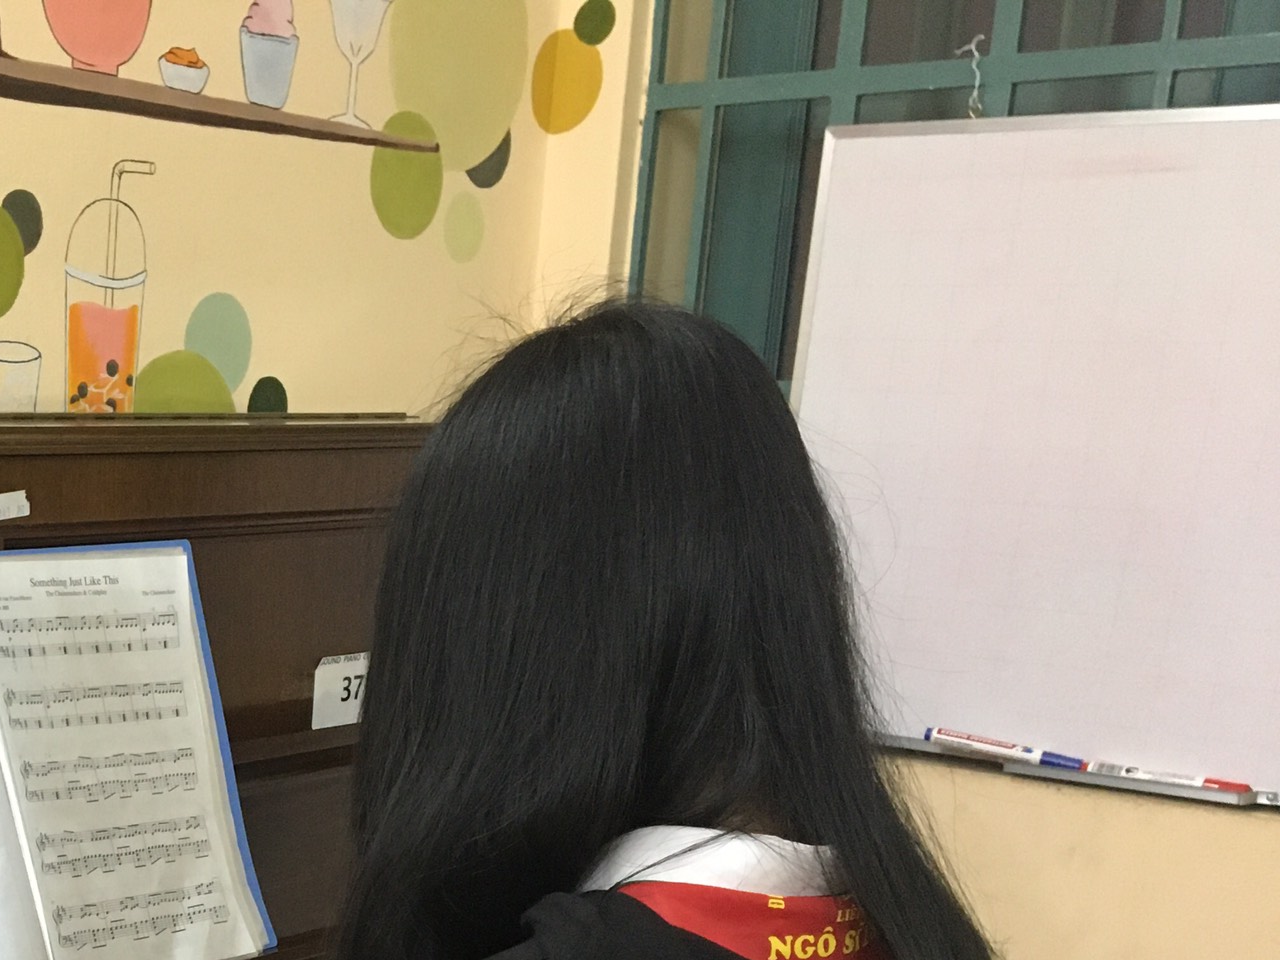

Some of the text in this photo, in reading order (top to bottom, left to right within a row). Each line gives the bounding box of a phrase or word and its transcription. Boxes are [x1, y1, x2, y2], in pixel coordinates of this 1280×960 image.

[29, 575, 119, 589] Something Just Like This
[341, 674, 365, 702] 37
[768, 926, 837, 960] NGÔ
